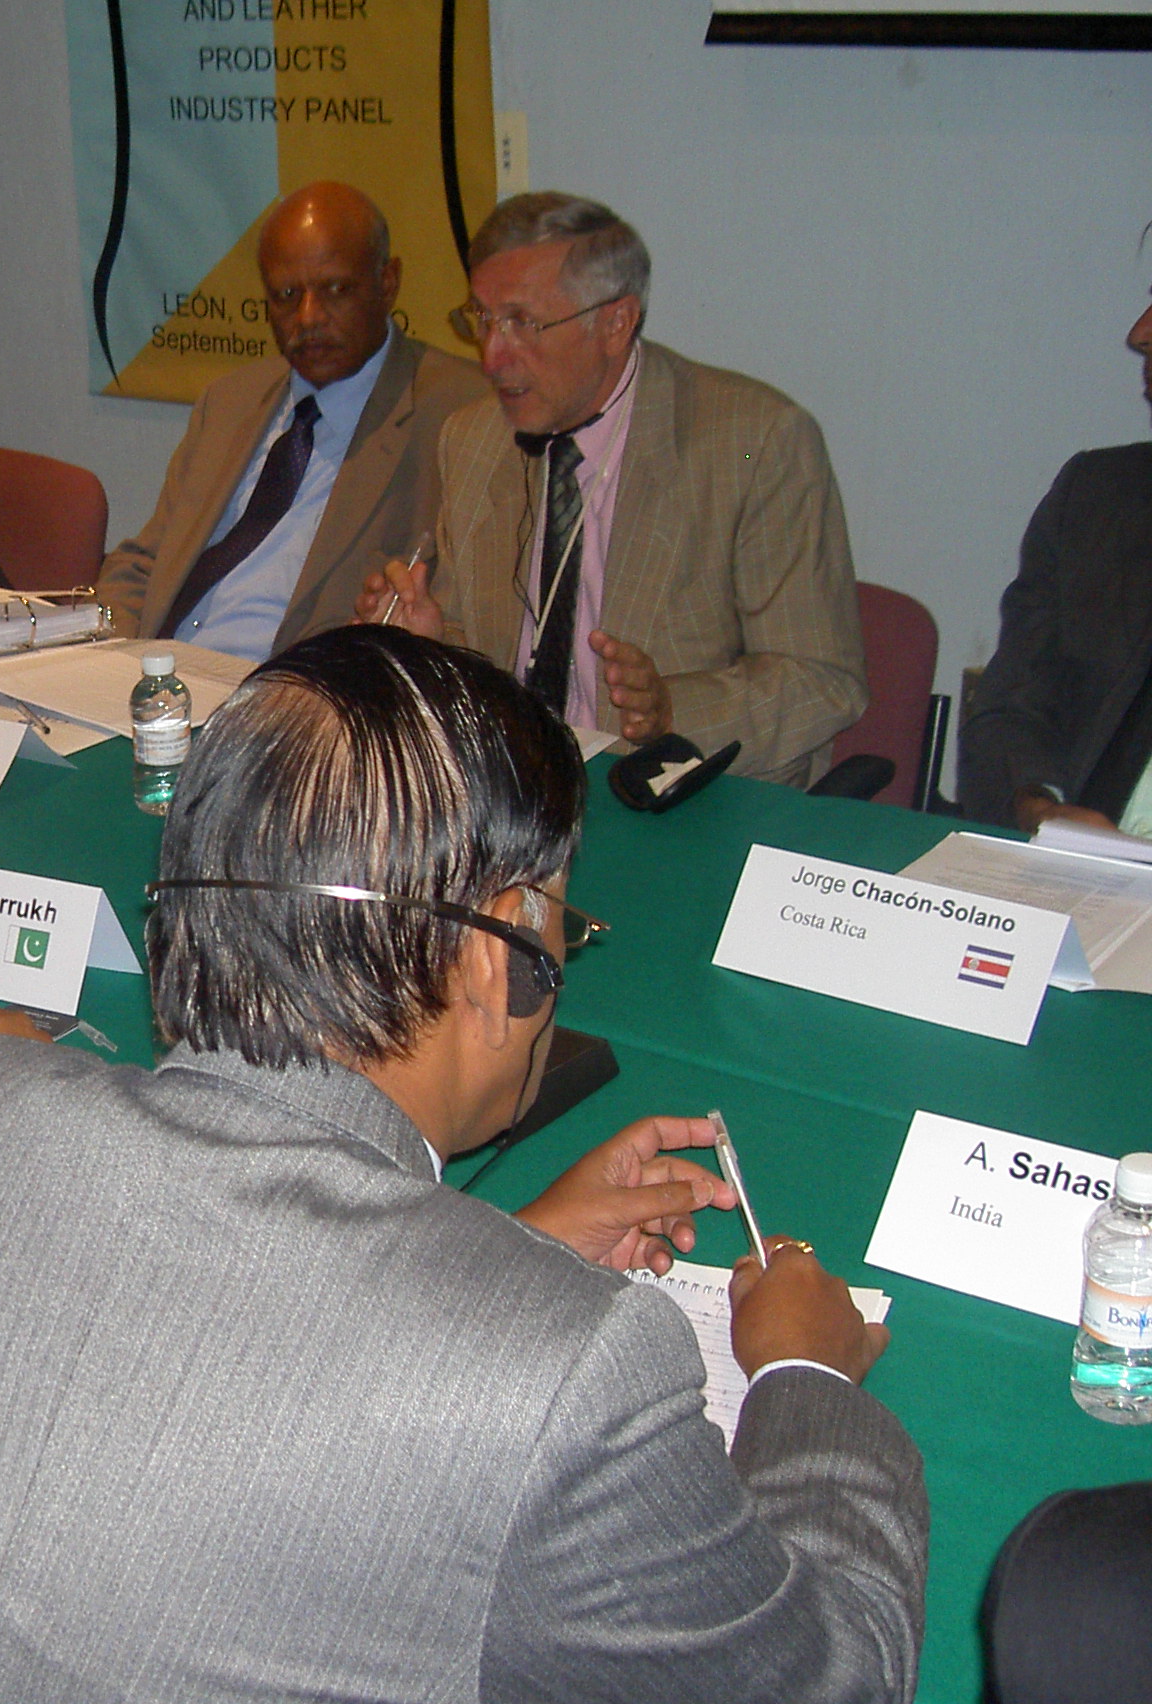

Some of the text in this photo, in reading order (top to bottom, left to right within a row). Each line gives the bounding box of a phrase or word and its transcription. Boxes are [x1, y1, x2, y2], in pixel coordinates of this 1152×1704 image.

[184, 0, 367, 22] AND LEATHER
[199, 46, 347, 73] PRODUCTS
[170, 96, 393, 126] INDUSTRY PANEL
[162, 288, 270, 325] LEÓN, GT
[151, 324, 268, 358] September
[791, 865, 1016, 933] Jorge Chacón-Solano
[779, 904, 867, 941] Costa Rica
[963, 1141, 1112, 1202] A. Sahas
[949, 1195, 1004, 1228] India
